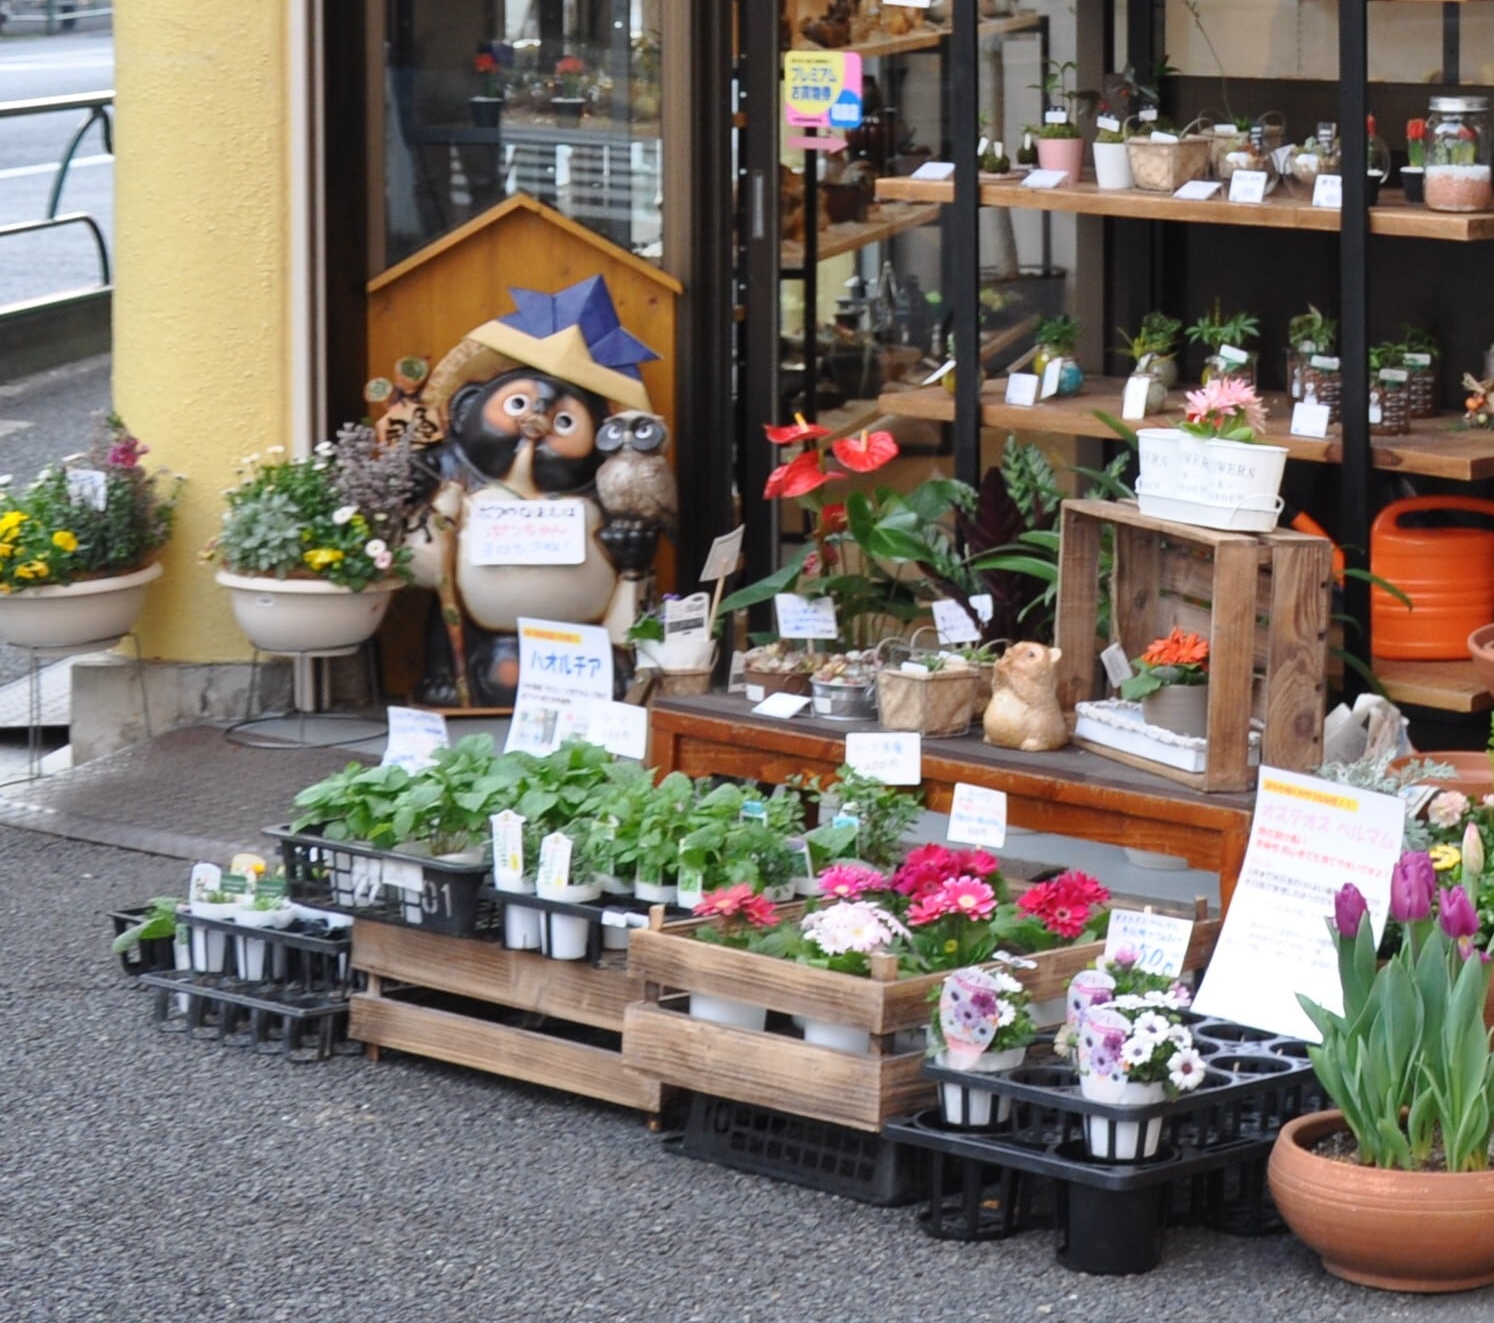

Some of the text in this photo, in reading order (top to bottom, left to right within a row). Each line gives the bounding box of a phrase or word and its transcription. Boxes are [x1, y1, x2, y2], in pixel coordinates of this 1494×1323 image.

[530, 650, 603, 678] ハオルチア
